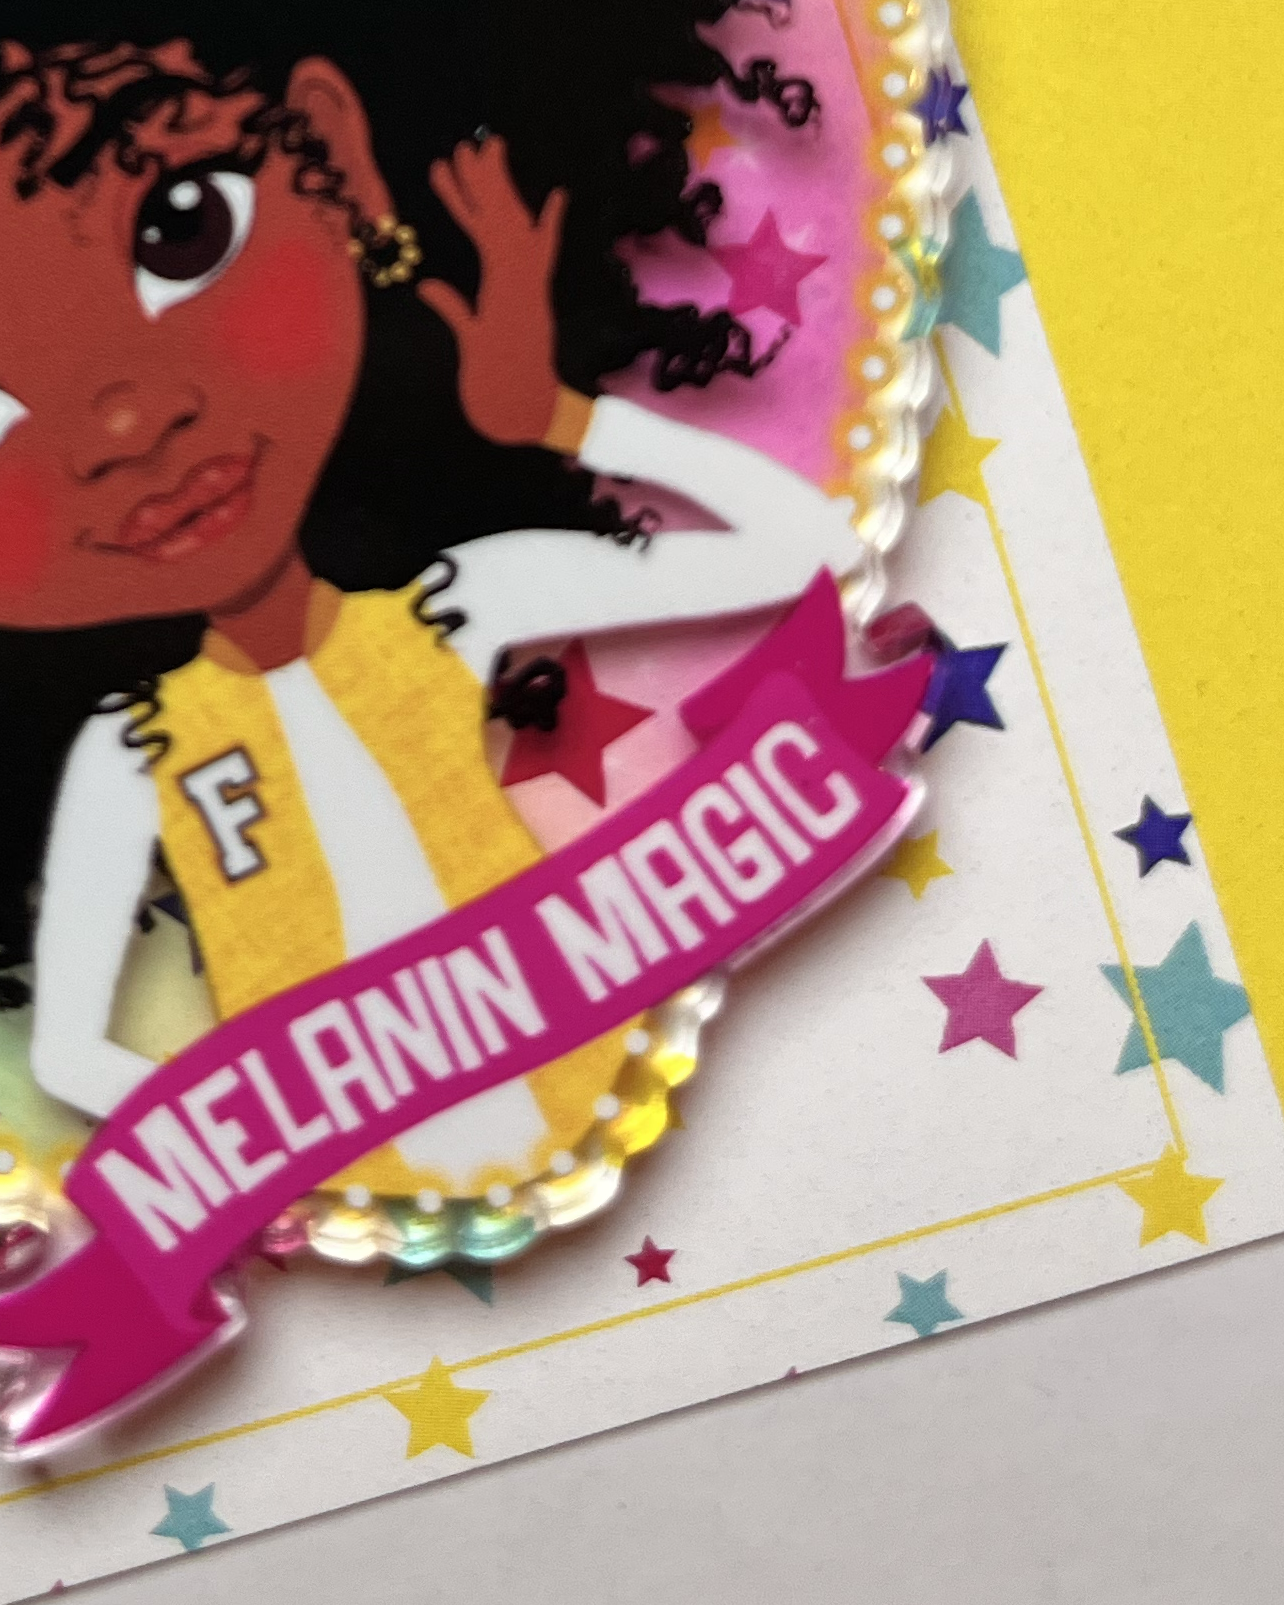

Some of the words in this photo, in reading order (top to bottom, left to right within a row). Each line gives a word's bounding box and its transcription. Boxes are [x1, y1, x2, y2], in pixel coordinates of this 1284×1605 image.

[178, 743, 269, 884] F
[93, 929, 546, 1251] MELANIN
[539, 722, 860, 1000] MAGIC
